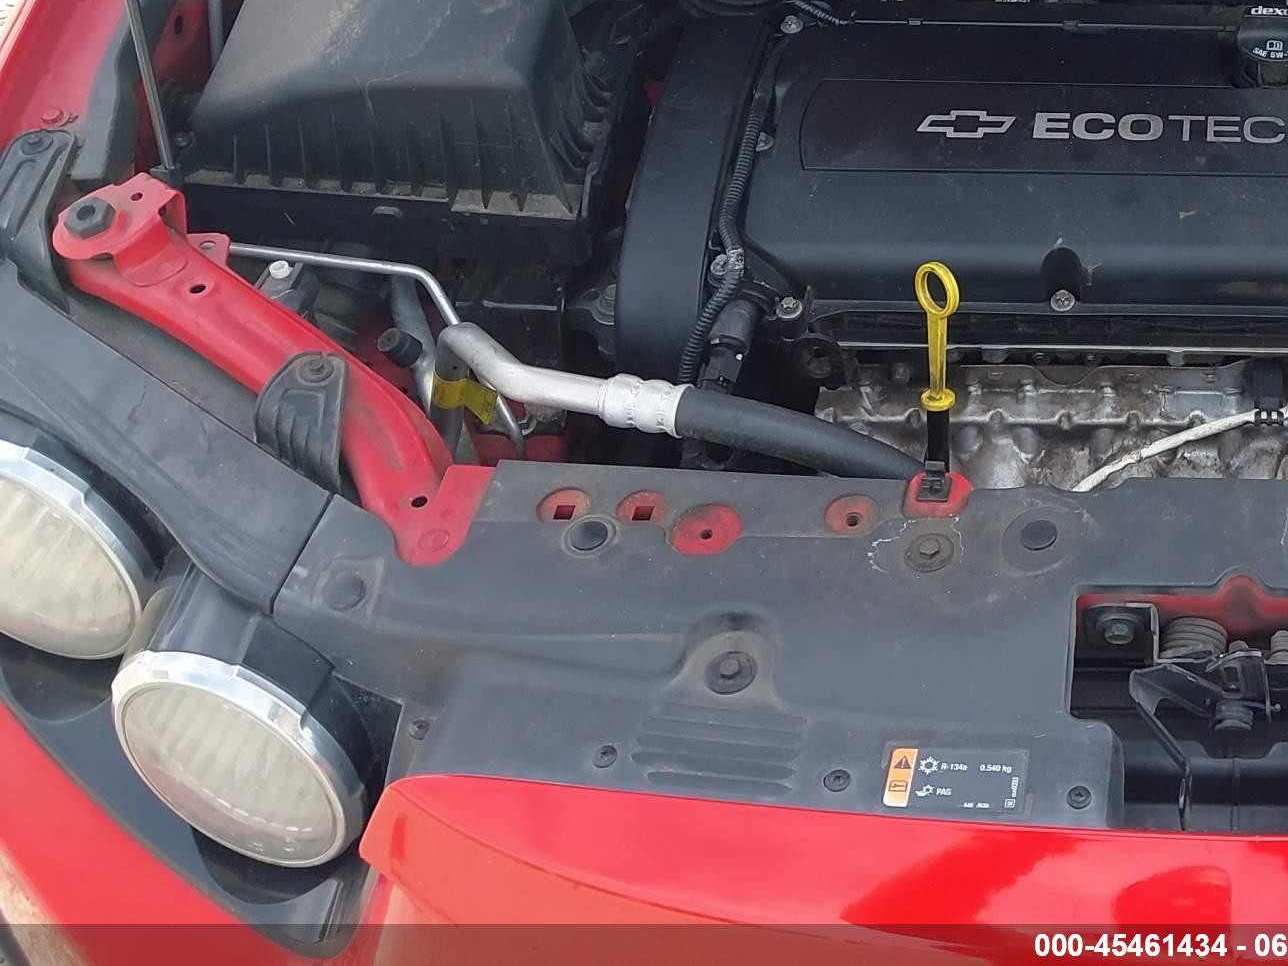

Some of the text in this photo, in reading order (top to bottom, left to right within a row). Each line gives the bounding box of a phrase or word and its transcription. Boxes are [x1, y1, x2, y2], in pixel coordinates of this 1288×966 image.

[1252, 47, 1268, 58] SAE
[1032, 111, 1286, 144] ECOTEC
[940, 761, 1013, 774] R-134a 0.540 kg
[936, 787, 951, 796] PAG
